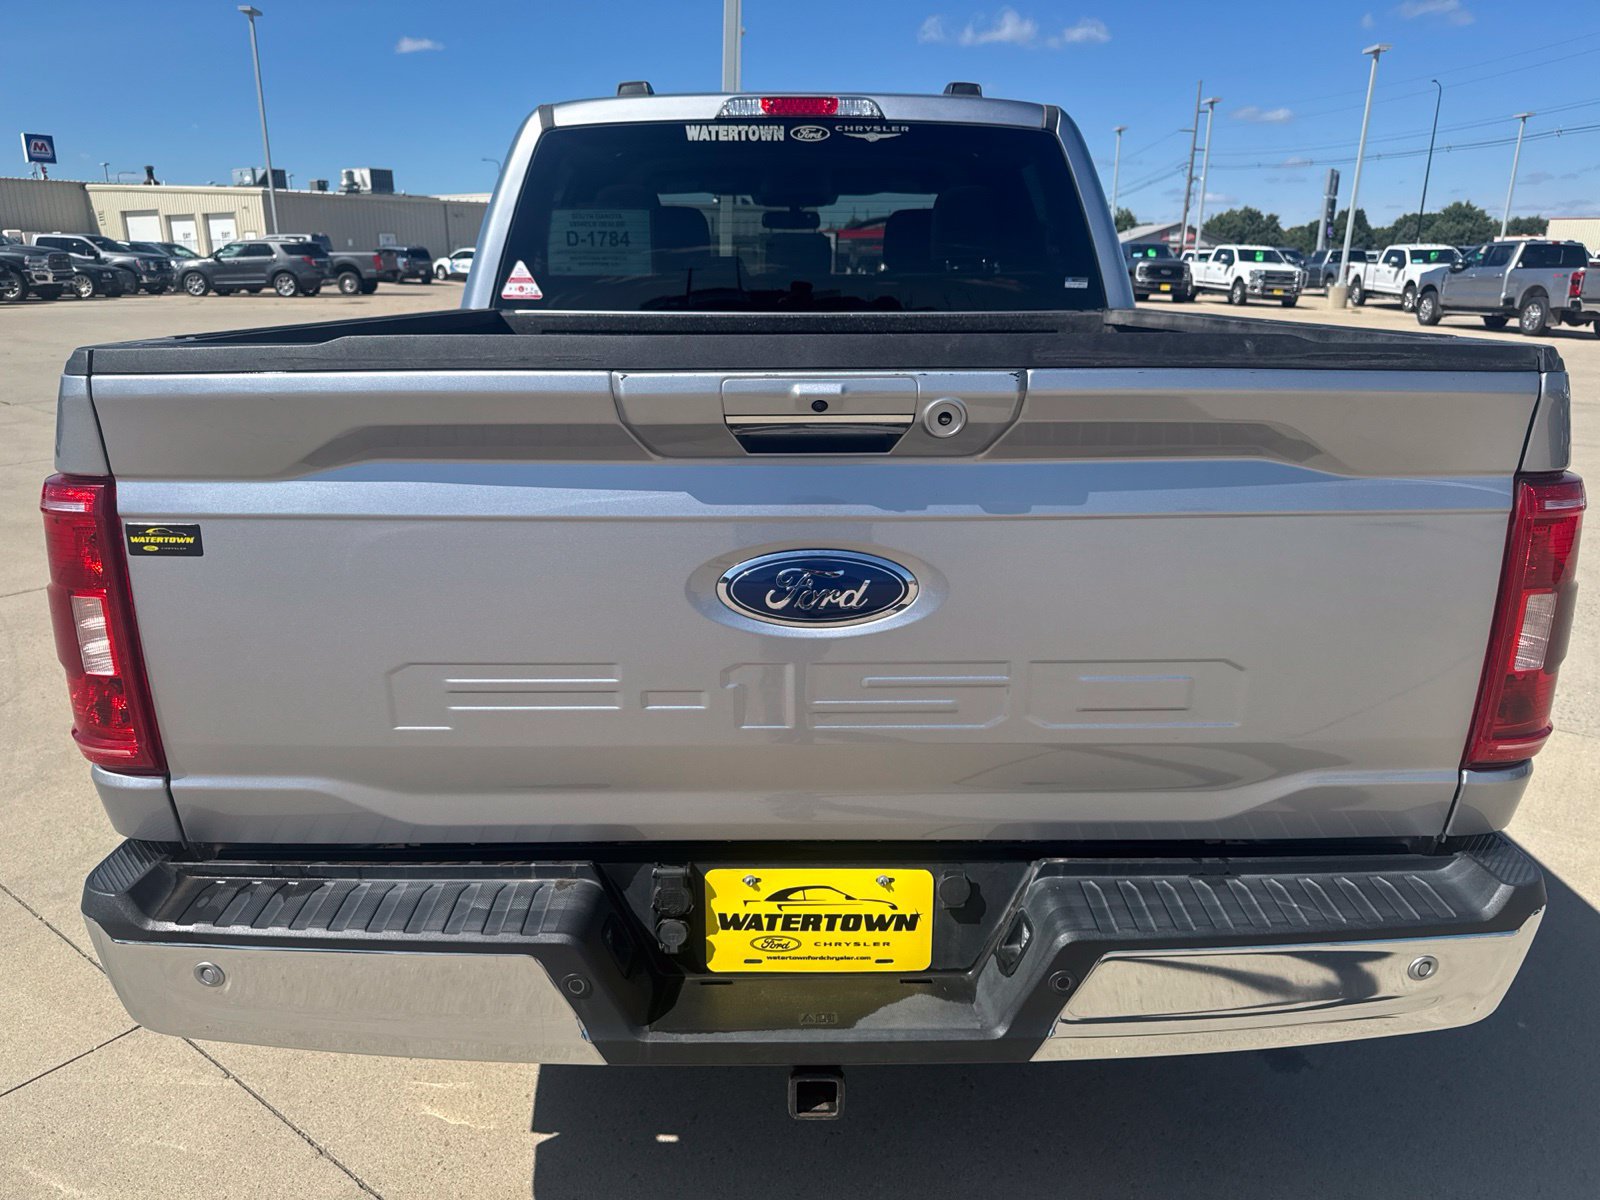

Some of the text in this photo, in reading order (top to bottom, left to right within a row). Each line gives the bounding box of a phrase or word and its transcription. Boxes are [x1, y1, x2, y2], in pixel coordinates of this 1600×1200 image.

[685, 125, 785, 142] WATERTOWN
[835, 125, 910, 133] CHRYSLER
[566, 230, 631, 248] D-1784
[130, 536, 196, 544] WATERTOWN
[765, 567, 872, 611] Ford
[386, 661, 1248, 732] F-150
[717, 912, 919, 932] WATERTOWN
[766, 954, 872, 962] watertownfordchrysler.com
